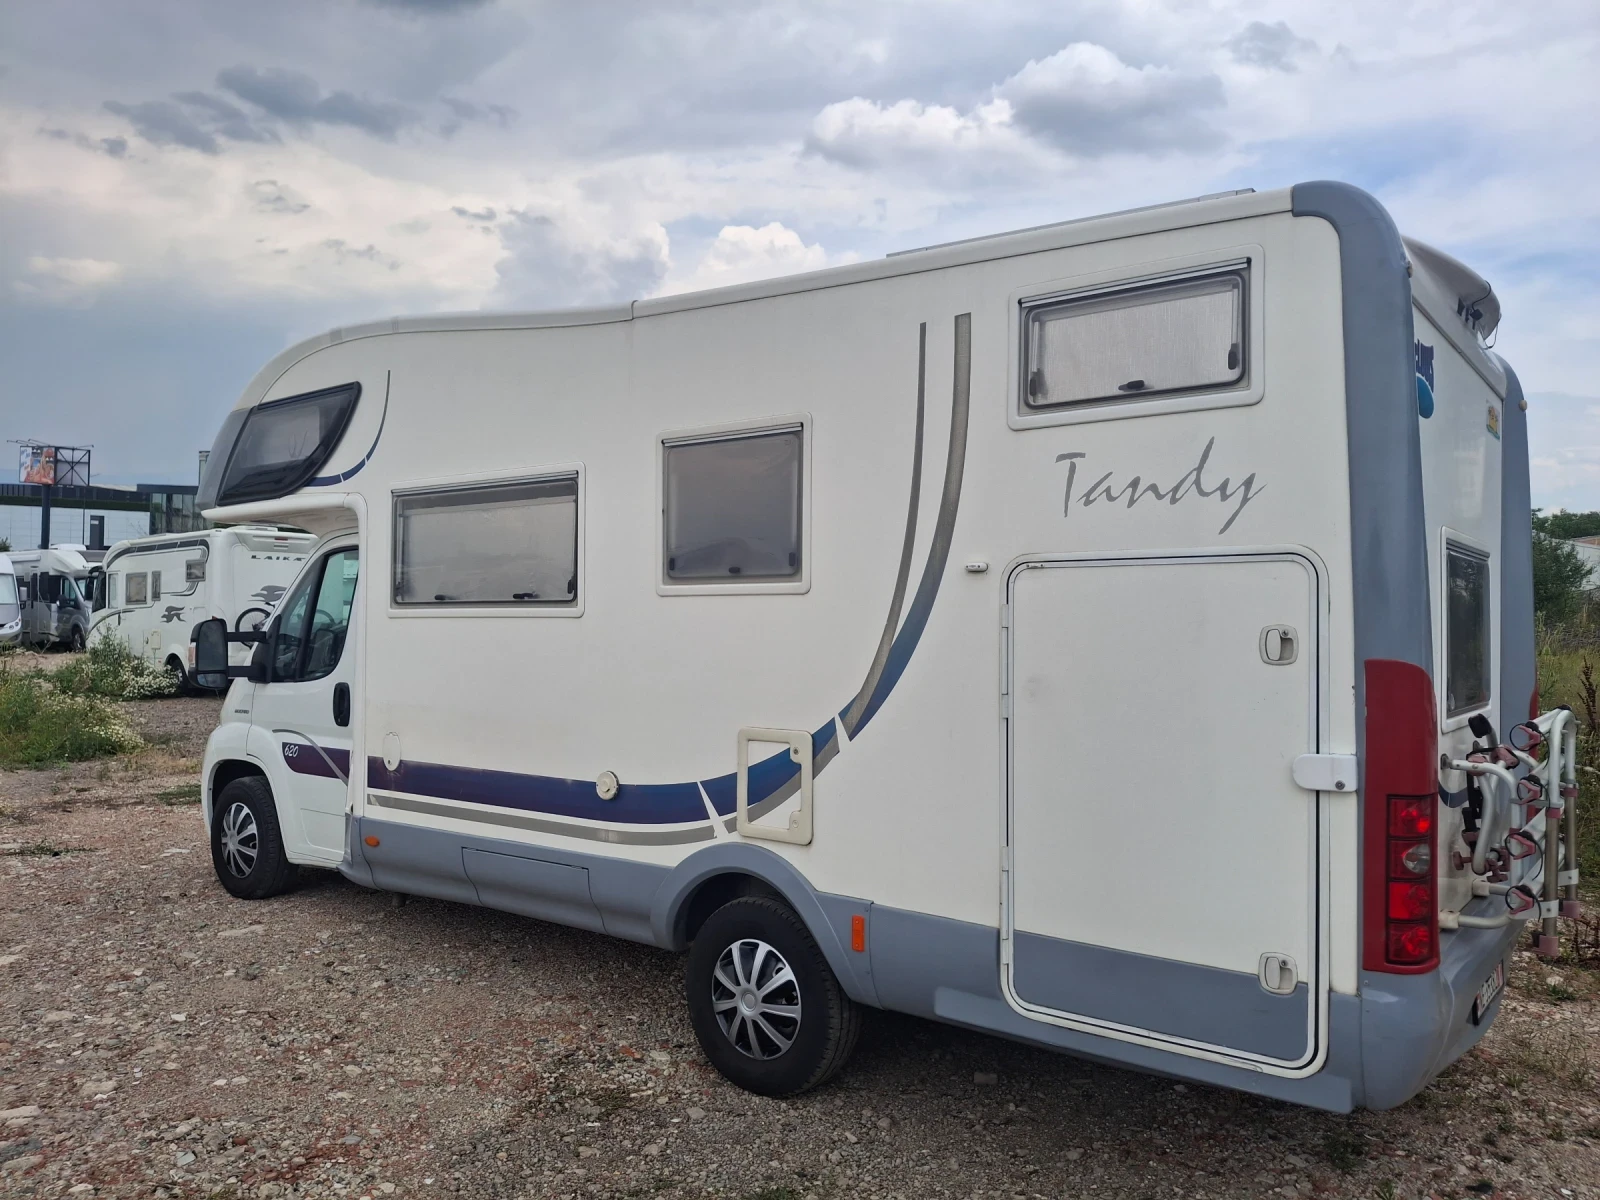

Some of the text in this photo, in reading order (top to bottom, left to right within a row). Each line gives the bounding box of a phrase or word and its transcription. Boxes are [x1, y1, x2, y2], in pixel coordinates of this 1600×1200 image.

[1055, 436, 1267, 535] Tandy
[251, 554, 306, 562] LAIKA
[284, 744, 299, 757] 620
